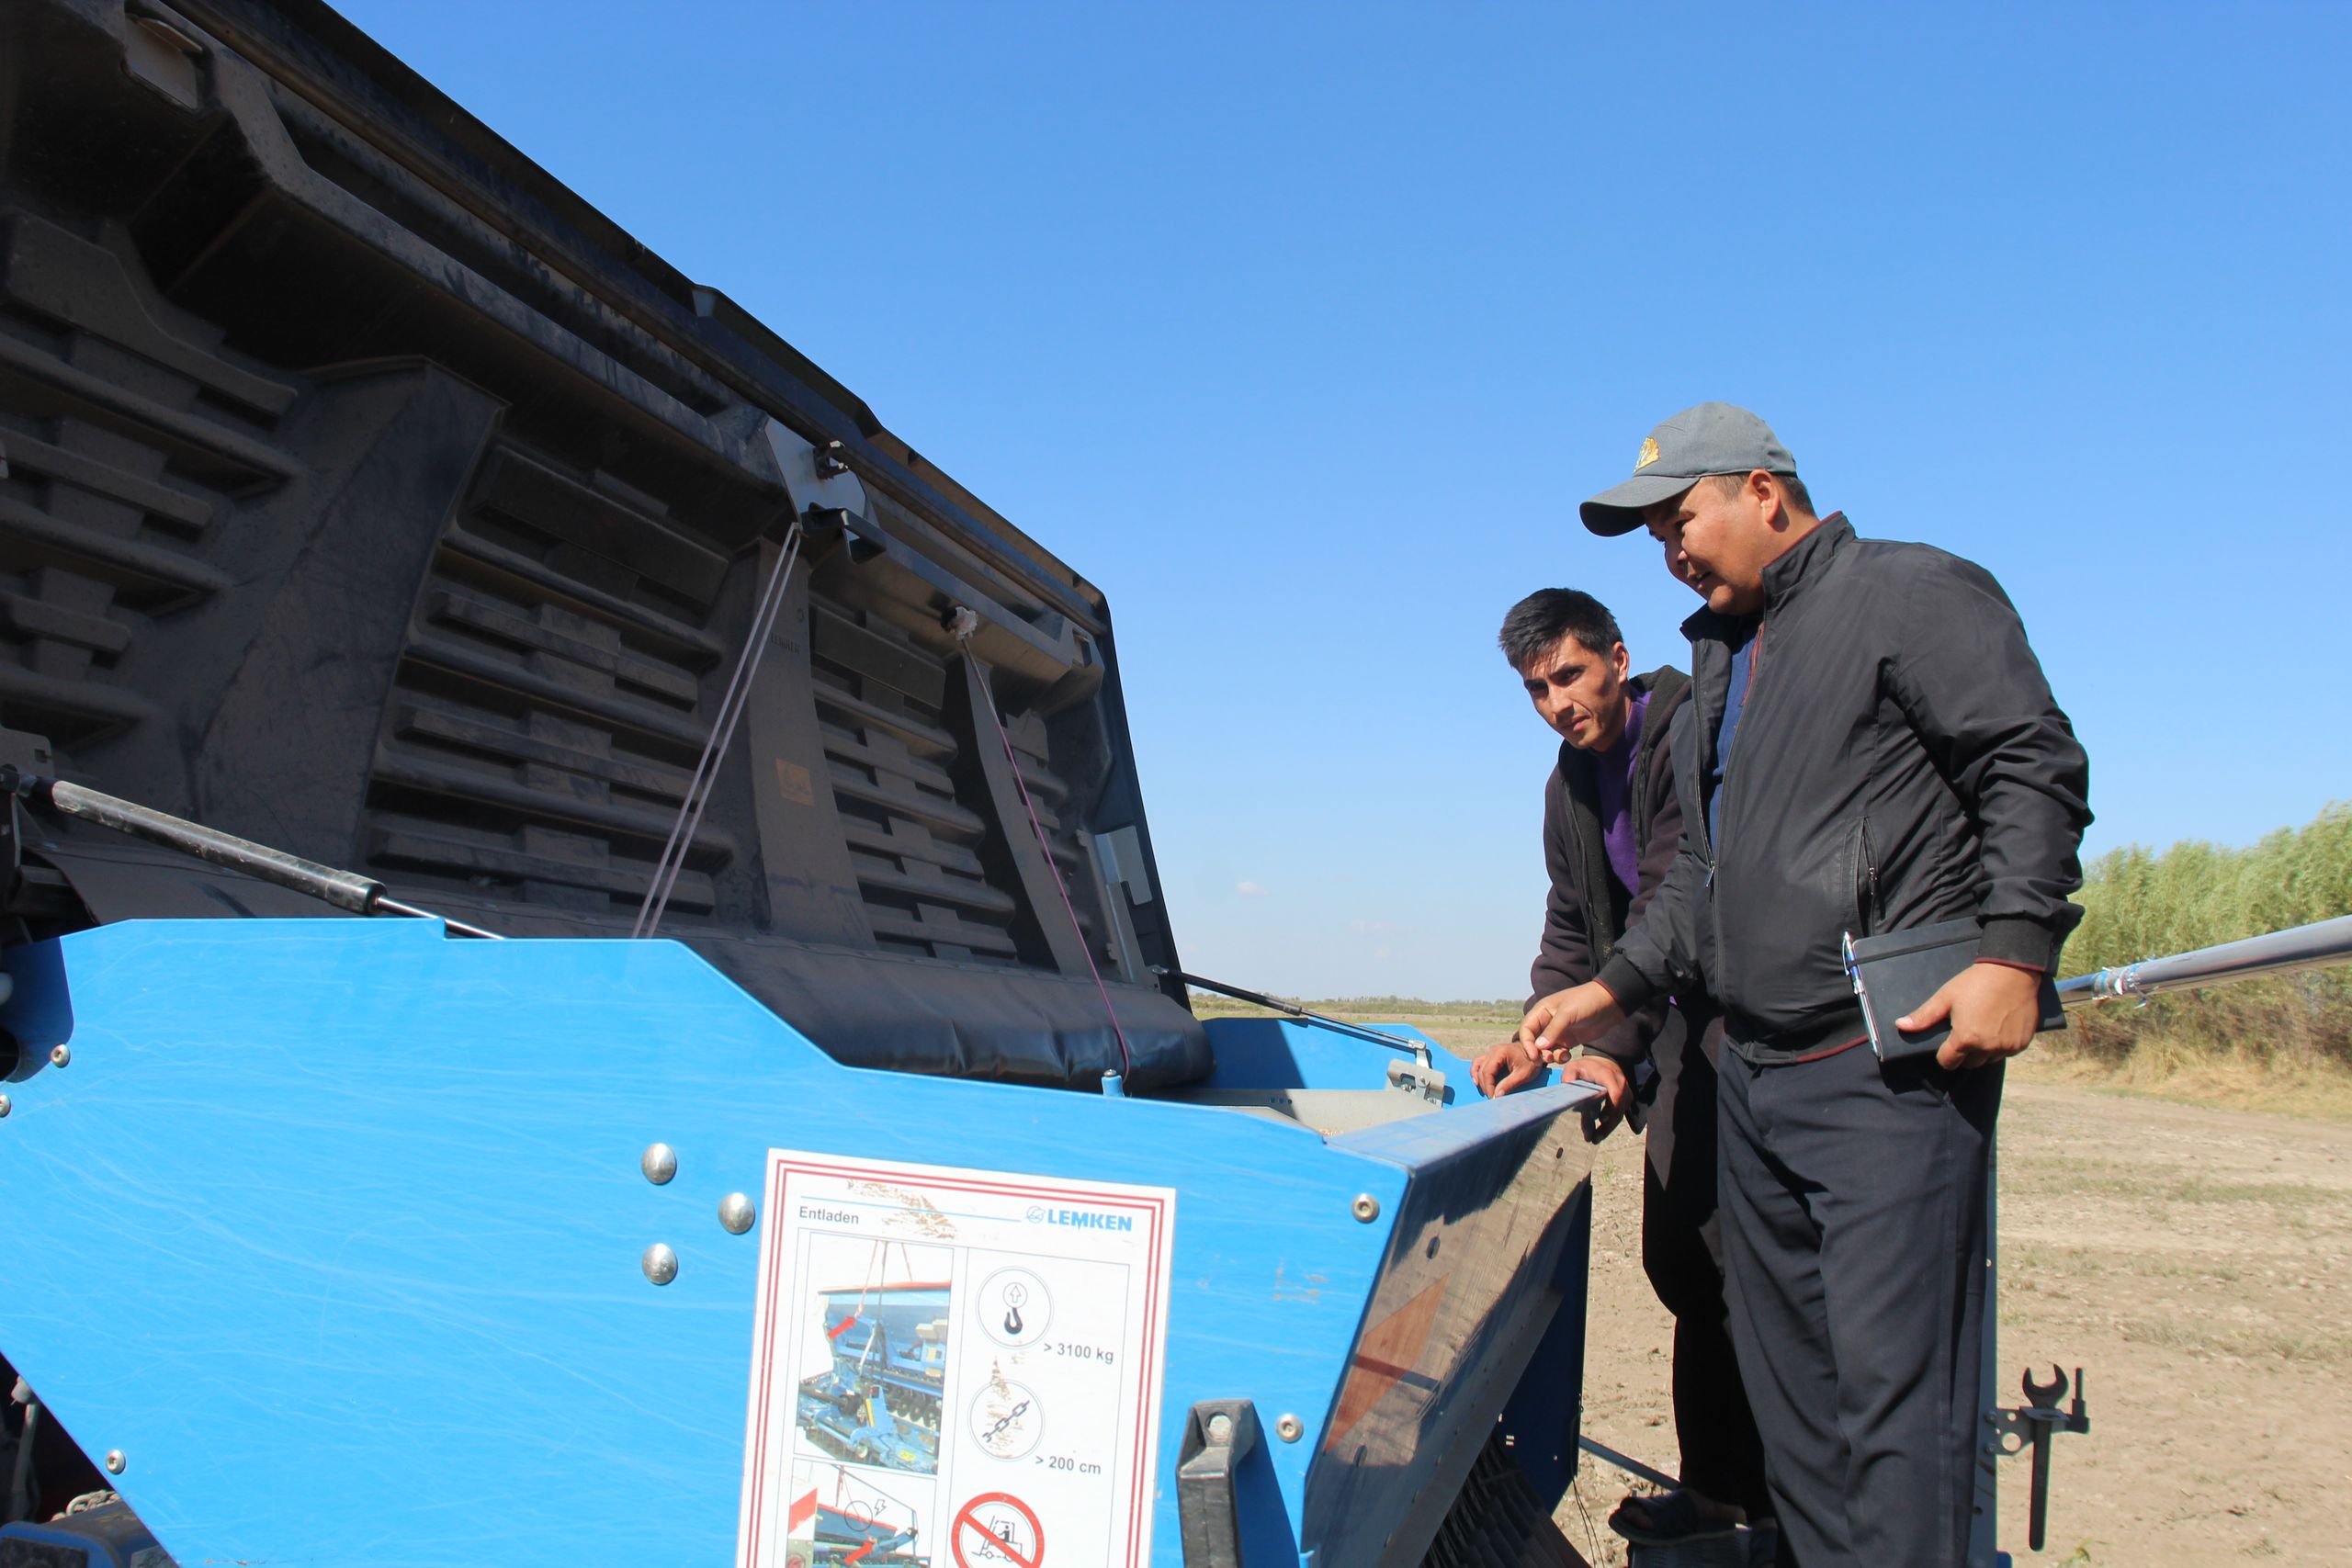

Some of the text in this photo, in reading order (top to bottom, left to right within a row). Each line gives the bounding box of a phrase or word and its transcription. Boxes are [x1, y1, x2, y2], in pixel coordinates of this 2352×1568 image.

[798, 1206, 860, 1224] Entladen
[1047, 1208, 1133, 1232] LEMKEN
[1057, 1343, 1091, 1359] 3100
[1096, 1348, 1114, 1365] kg
[1048, 1456, 1075, 1471] 200
[1079, 1462, 1102, 1474] cm
